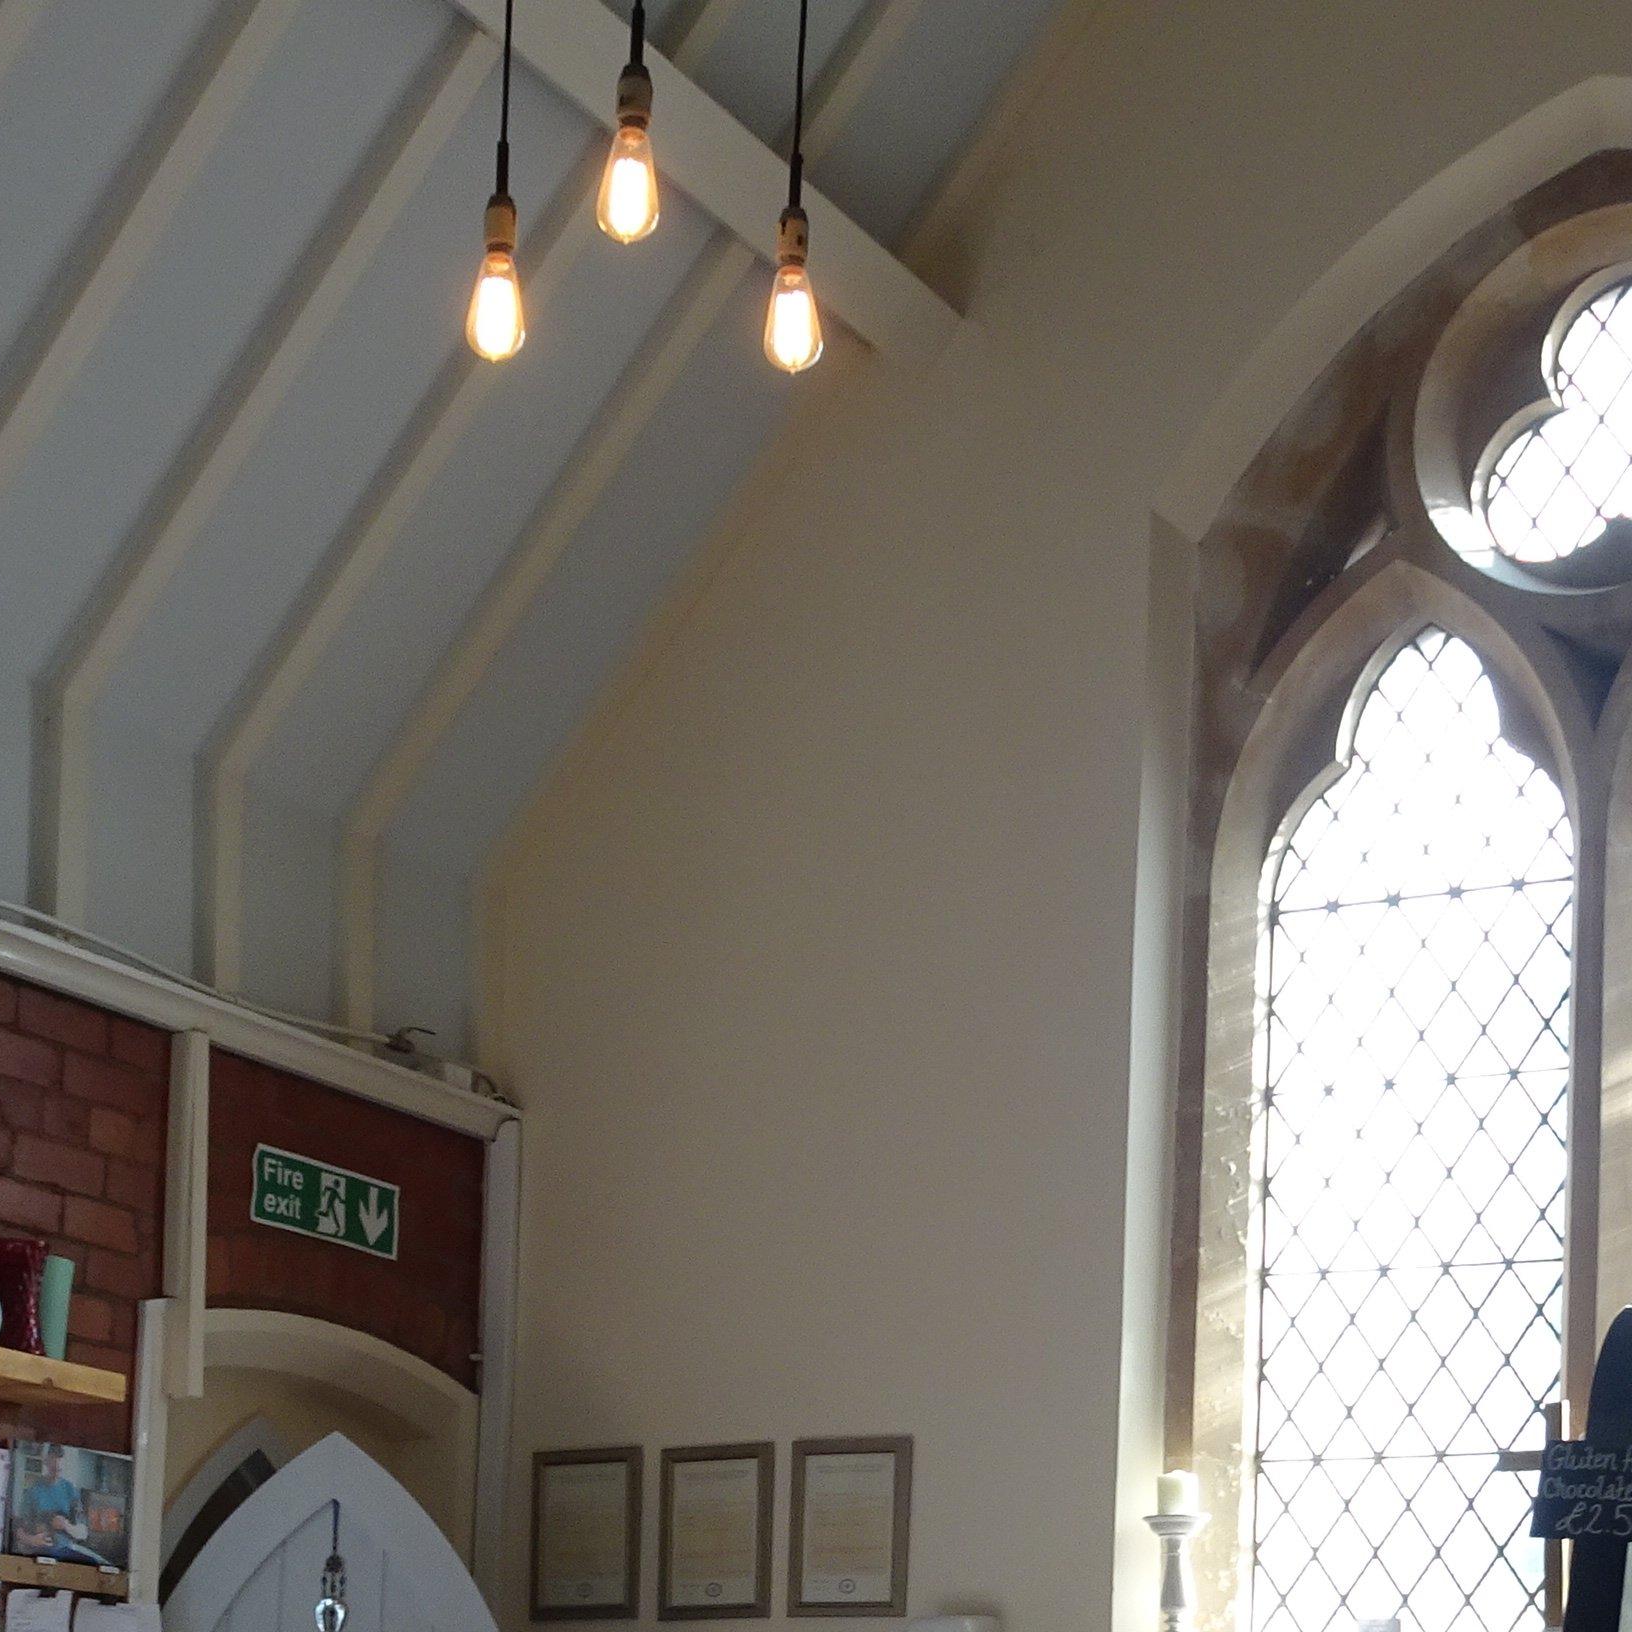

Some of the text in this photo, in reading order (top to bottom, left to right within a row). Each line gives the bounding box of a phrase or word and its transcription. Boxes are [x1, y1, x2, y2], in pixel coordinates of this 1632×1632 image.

[263, 1157, 305, 1191] Fire
[263, 1192, 302, 1220] exit
[1547, 1443, 1618, 1471] Gluten
